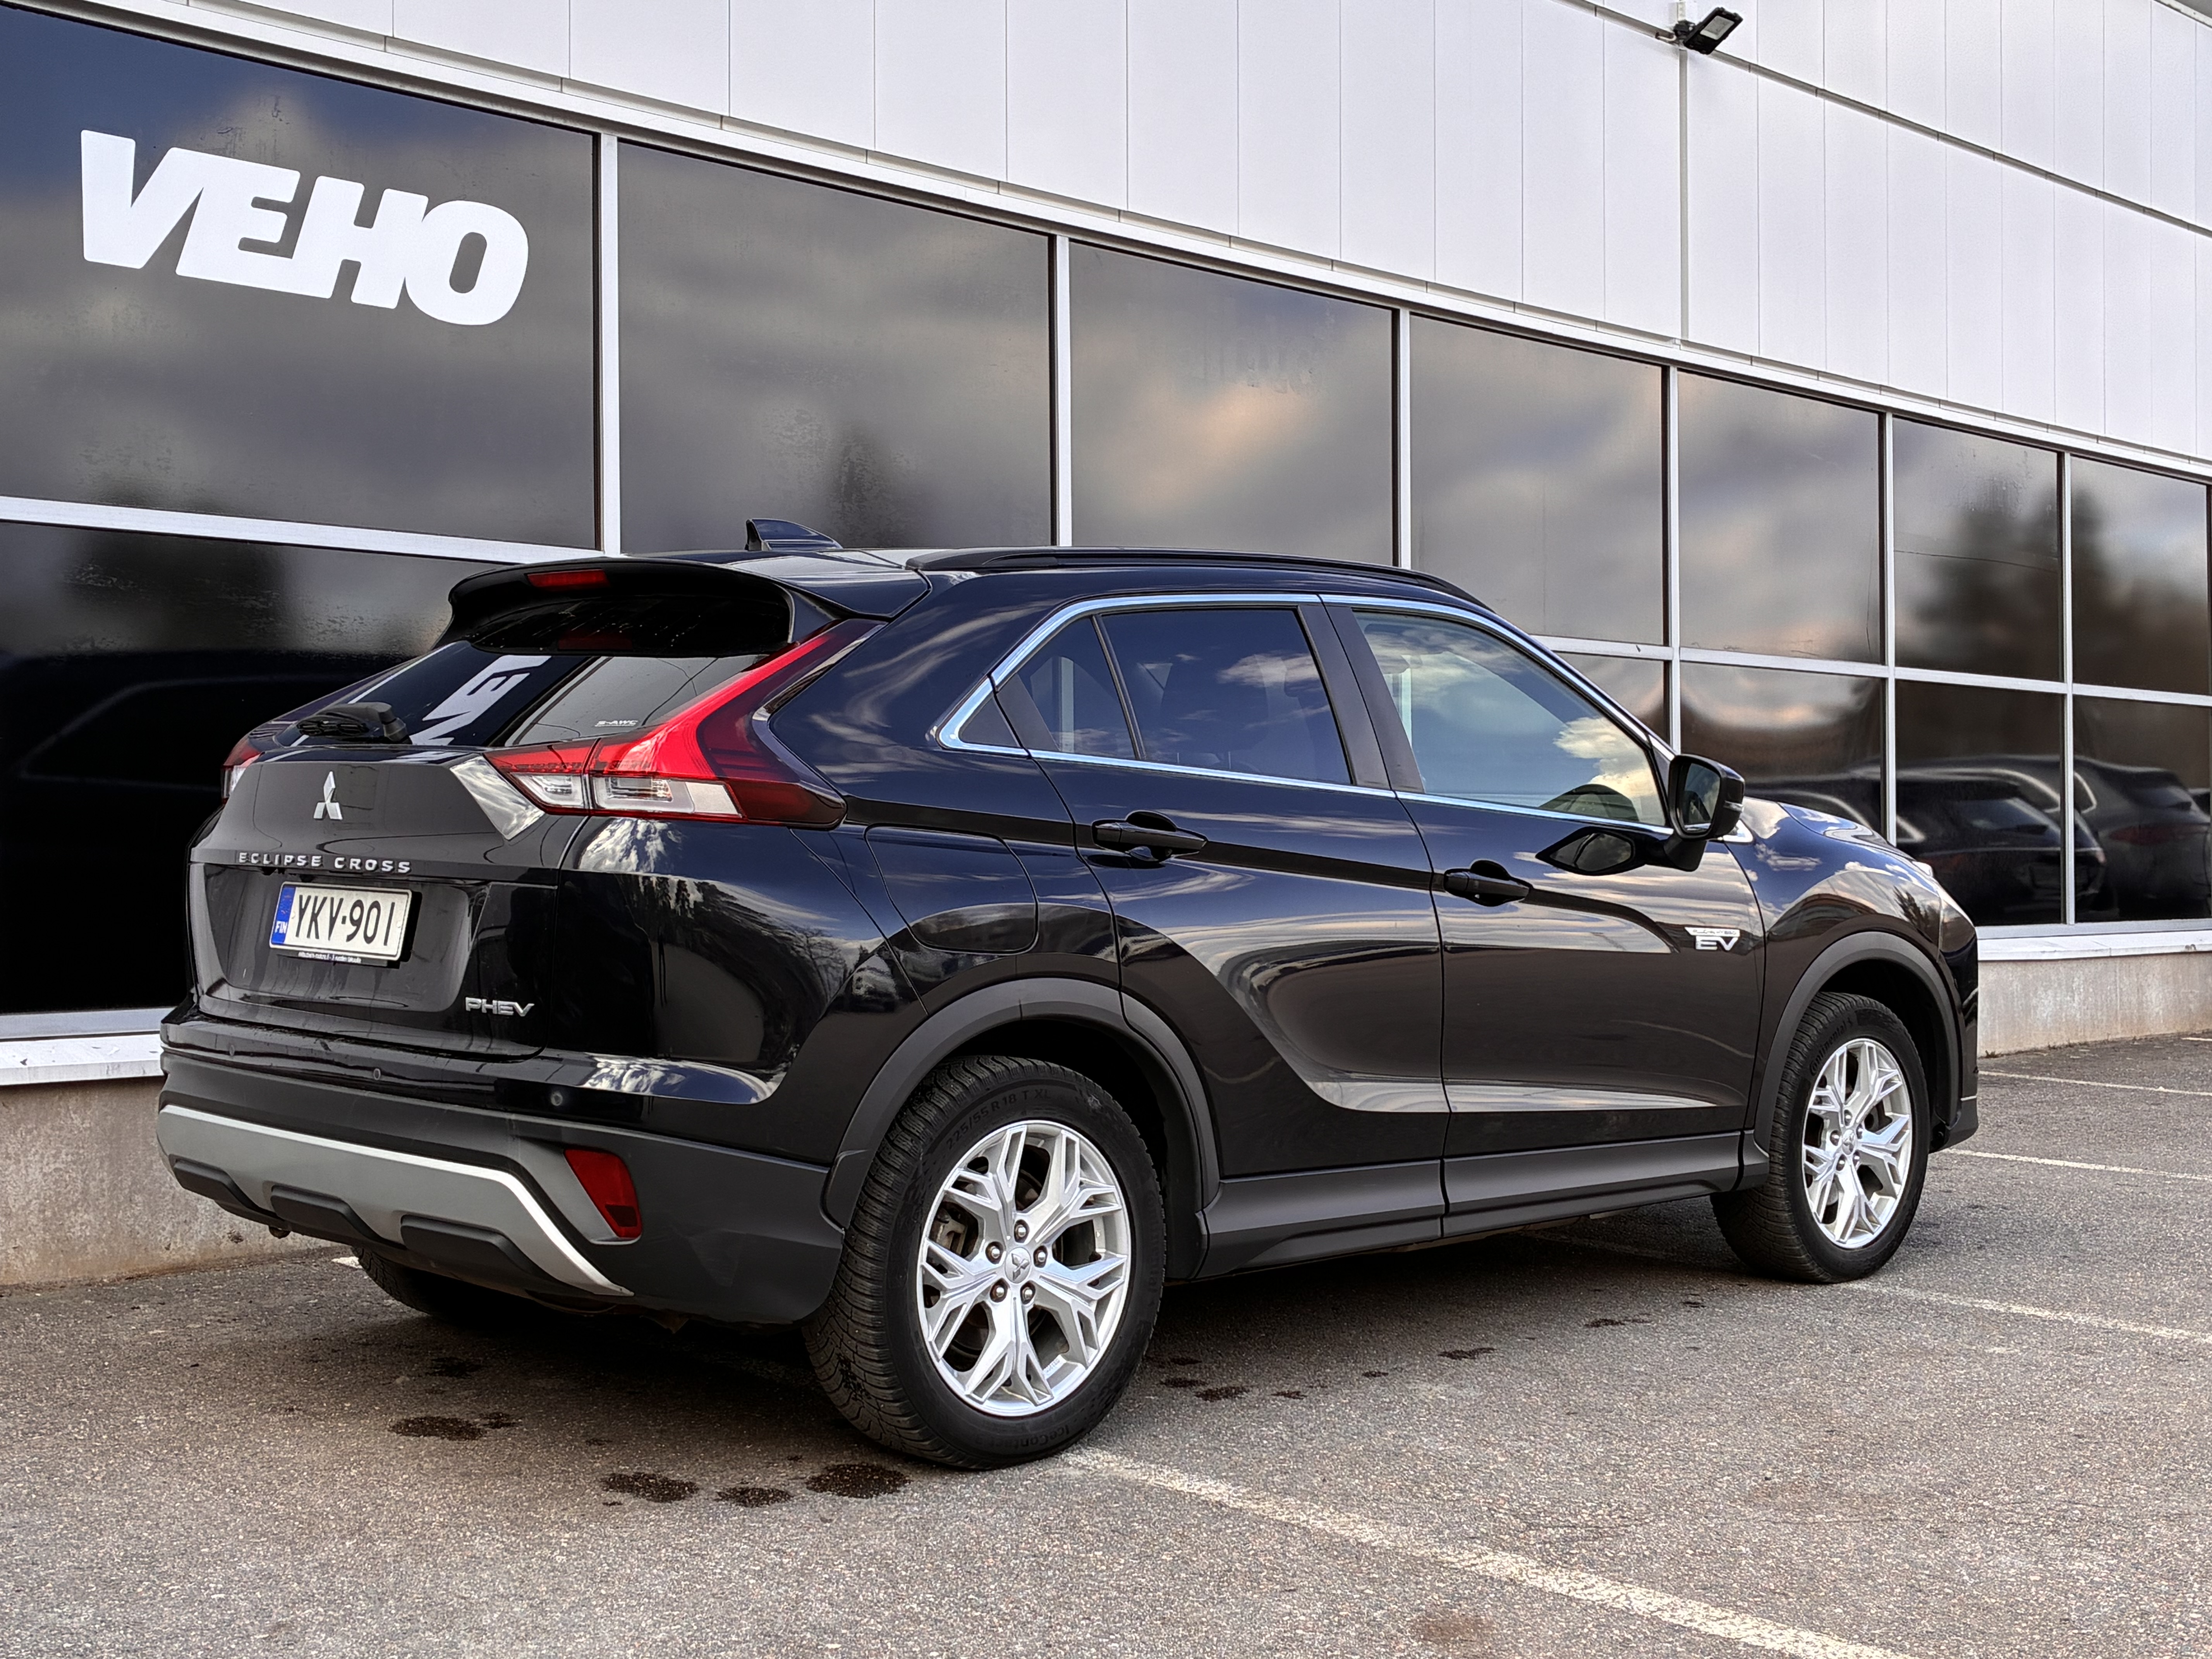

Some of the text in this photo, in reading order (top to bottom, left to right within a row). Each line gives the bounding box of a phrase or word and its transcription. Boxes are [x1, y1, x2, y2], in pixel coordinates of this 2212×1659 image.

[81, 129, 529, 325] VEHO
[239, 852, 410, 873] ECLIPSE CROSS
[274, 921, 289, 934] FIN
[295, 895, 395, 946] YKV-901
[1695, 935, 1738, 951] EV
[465, 996, 535, 1017] PHEV
[946, 1106, 989, 1150] 225/55
